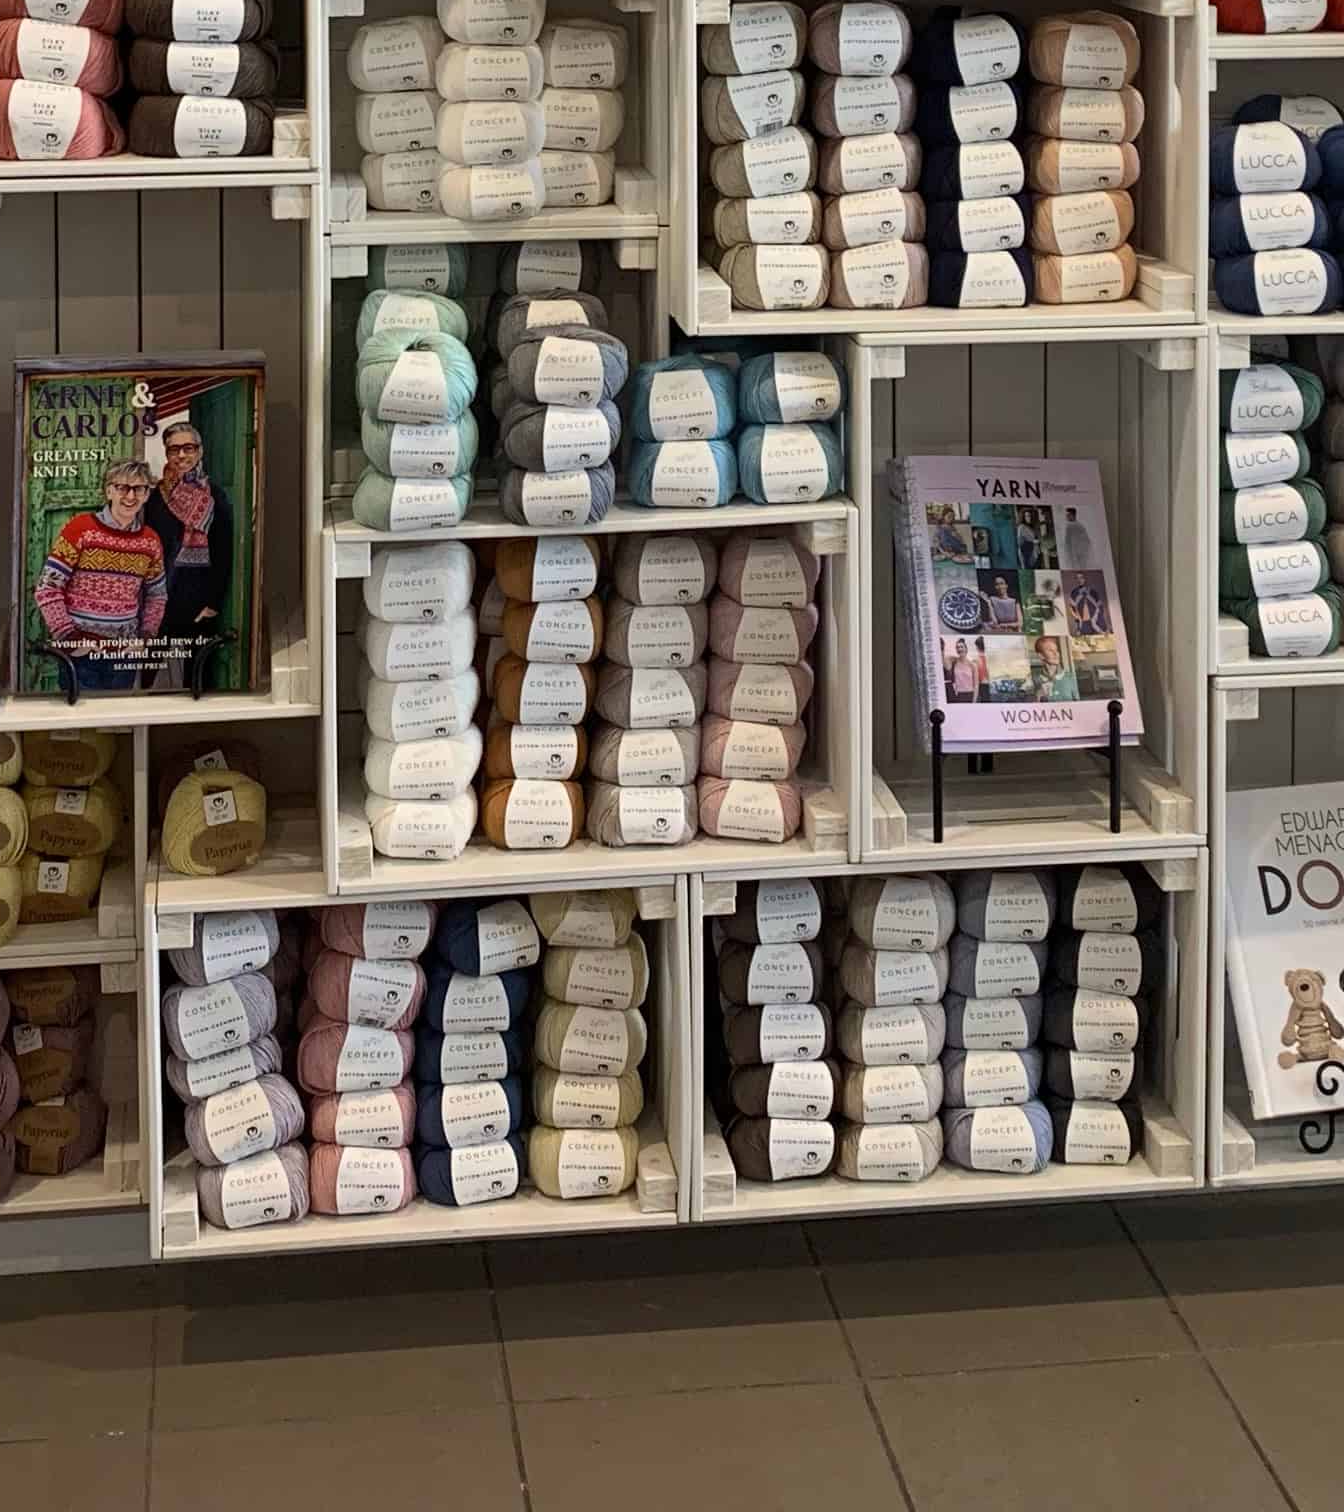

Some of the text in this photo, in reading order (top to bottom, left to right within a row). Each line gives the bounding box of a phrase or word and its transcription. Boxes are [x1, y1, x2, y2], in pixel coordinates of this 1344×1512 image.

[1240, 153, 1297, 169] LUCCA
[35, 382, 157, 409] ARNE &
[1237, 405, 1295, 418] LUCCA
[31, 409, 160, 439] CARLOS
[33, 448, 106, 463] GREATEST
[33, 464, 78, 479] KNITS
[976, 478, 1041, 499] YARN
[540, 557, 588, 567] CONCEPT
[99, 634, 144, 649] projects
[146, 634, 168, 646] and
[170, 637, 193, 646] new
[89, 646, 192, 660] to knit and crochet
[529, 680, 579, 688] CONCEPT
[1000, 708, 1074, 724] WOMAN
[1086, 946, 1133, 954] CONCEPT
[768, 1013, 816, 1022] CONCEPT
